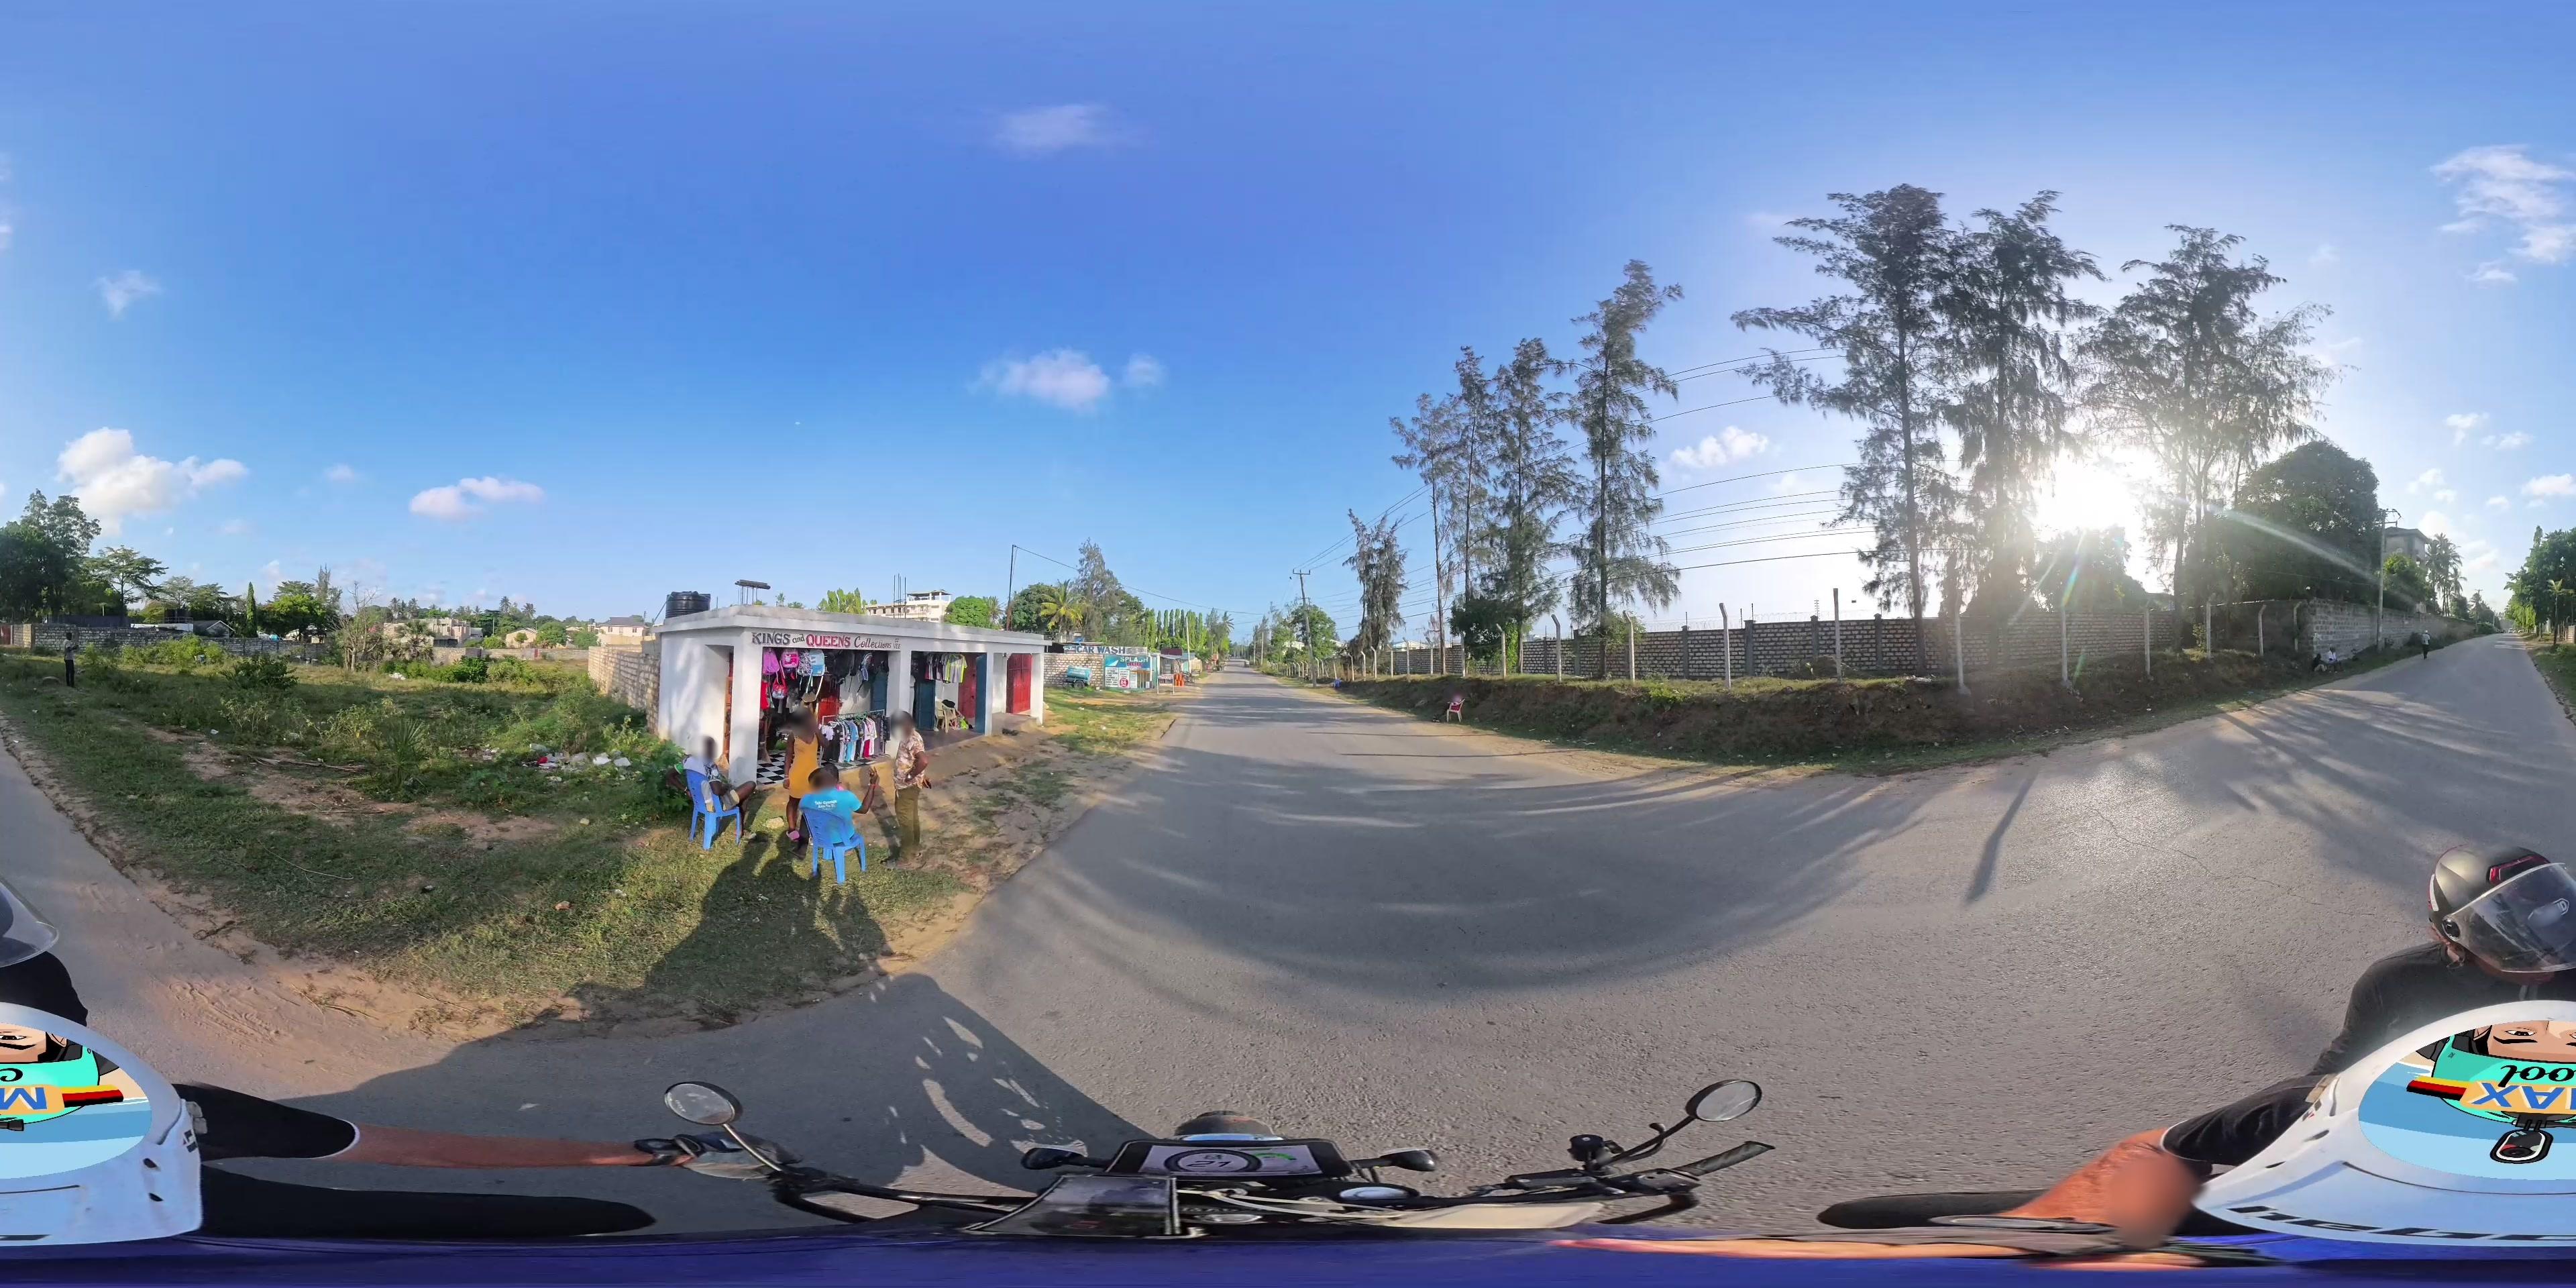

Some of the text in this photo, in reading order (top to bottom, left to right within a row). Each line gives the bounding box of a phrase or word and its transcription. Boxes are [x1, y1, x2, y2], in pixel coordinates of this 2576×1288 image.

[751, 631, 790, 645] KINGS
[792, 633, 805, 643] and
[806, 634, 851, 648] QUEENS
[1076, 645, 1095, 653] CAR
[1097, 645, 1126, 655] WASH
